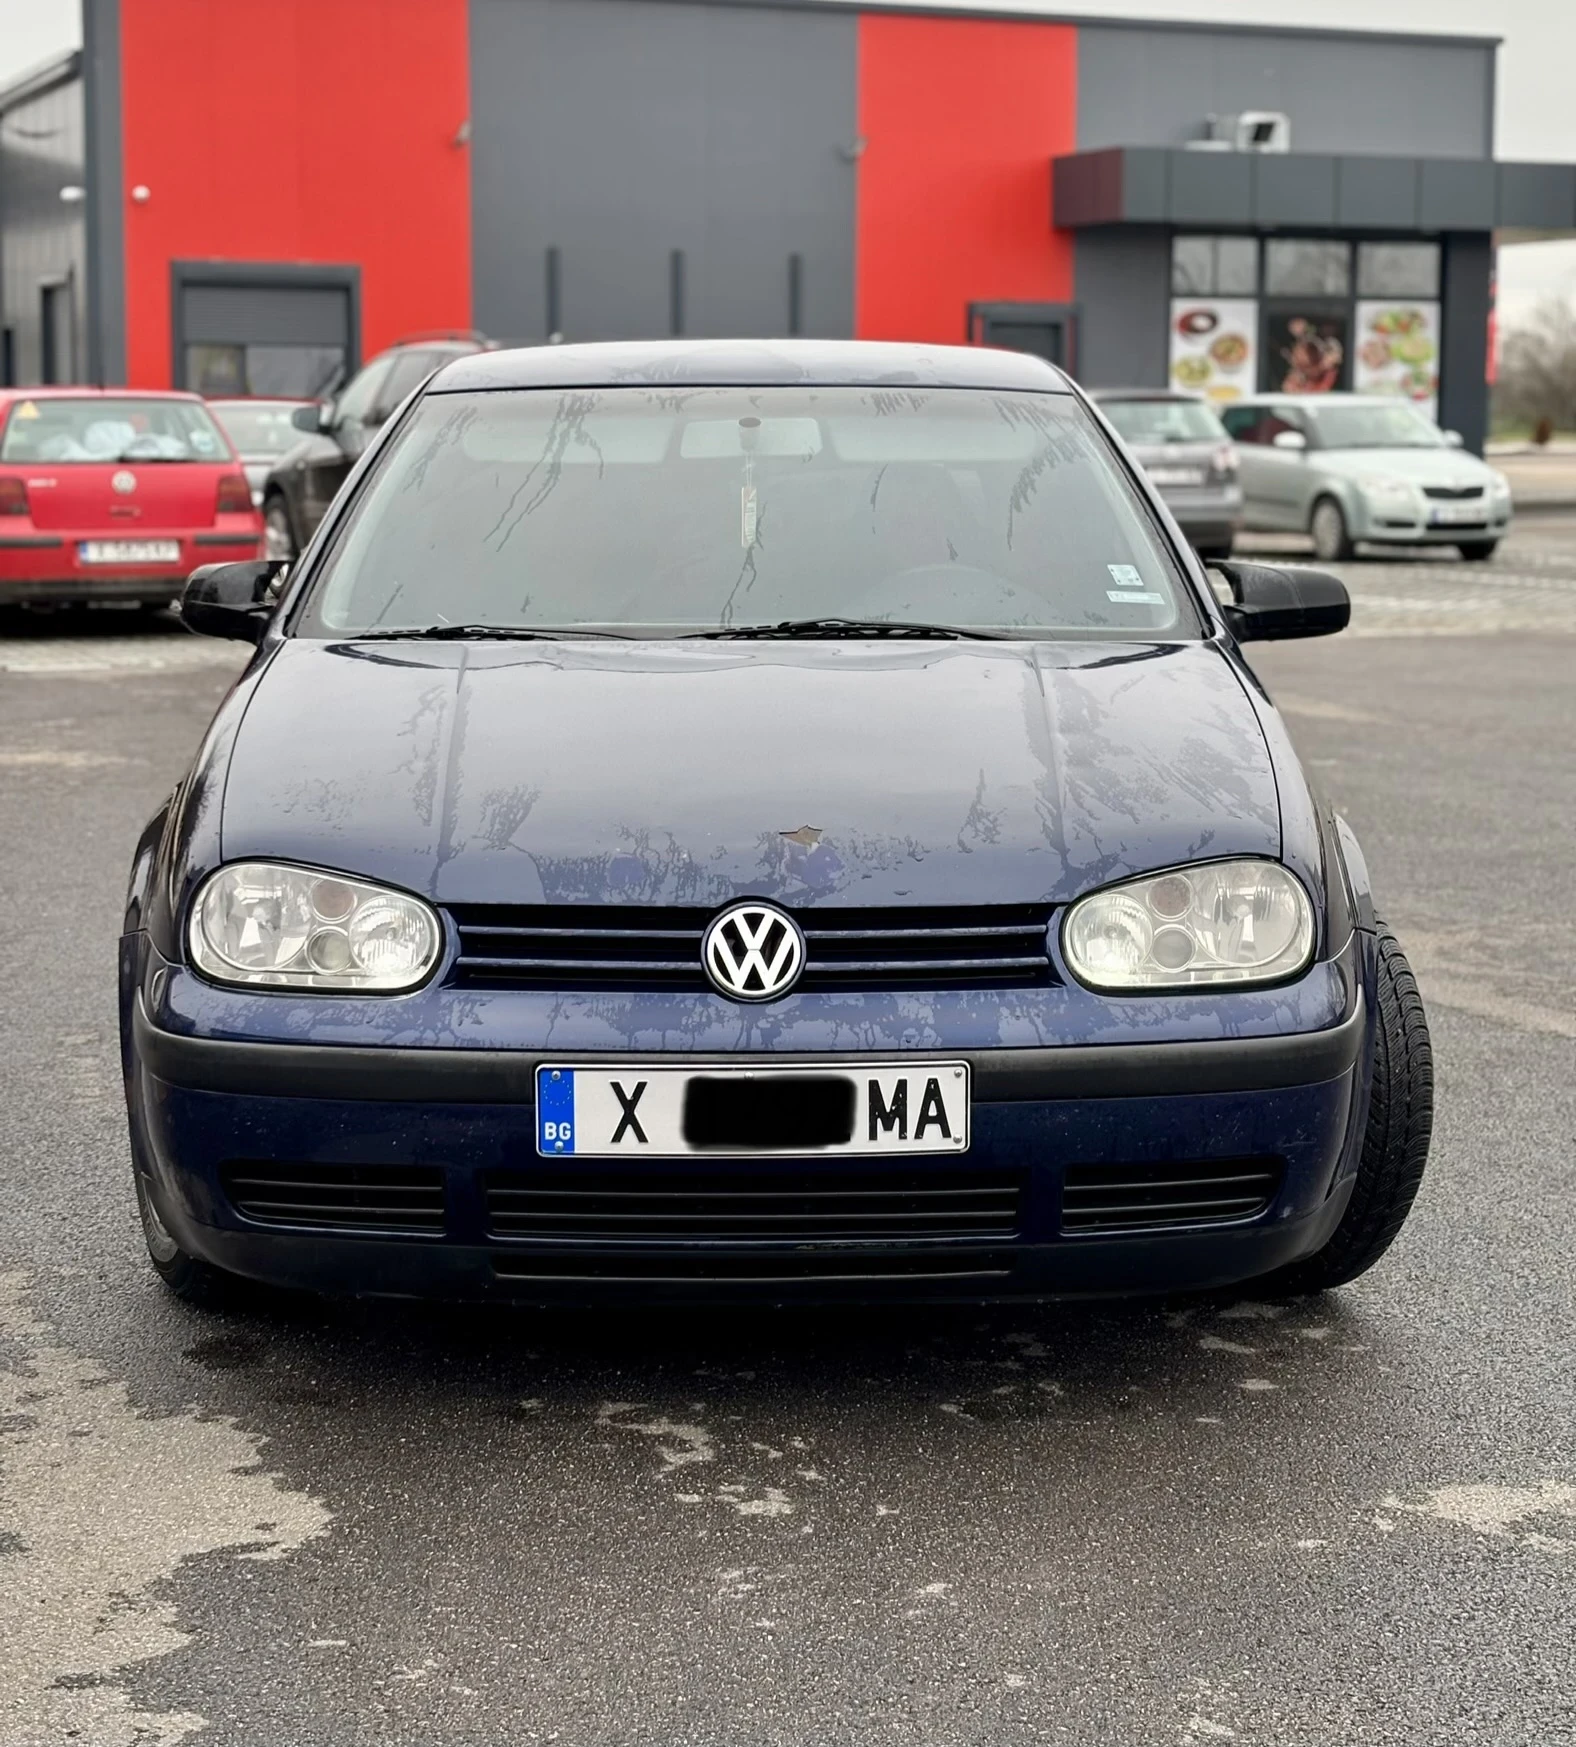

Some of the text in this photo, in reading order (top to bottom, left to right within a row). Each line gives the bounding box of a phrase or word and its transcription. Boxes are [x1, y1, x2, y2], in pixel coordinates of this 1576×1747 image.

[706, 905, 801, 997] VW
[544, 1121, 571, 1140] BG
[610, 1081, 649, 1143] X
[868, 1078, 952, 1140] MA
